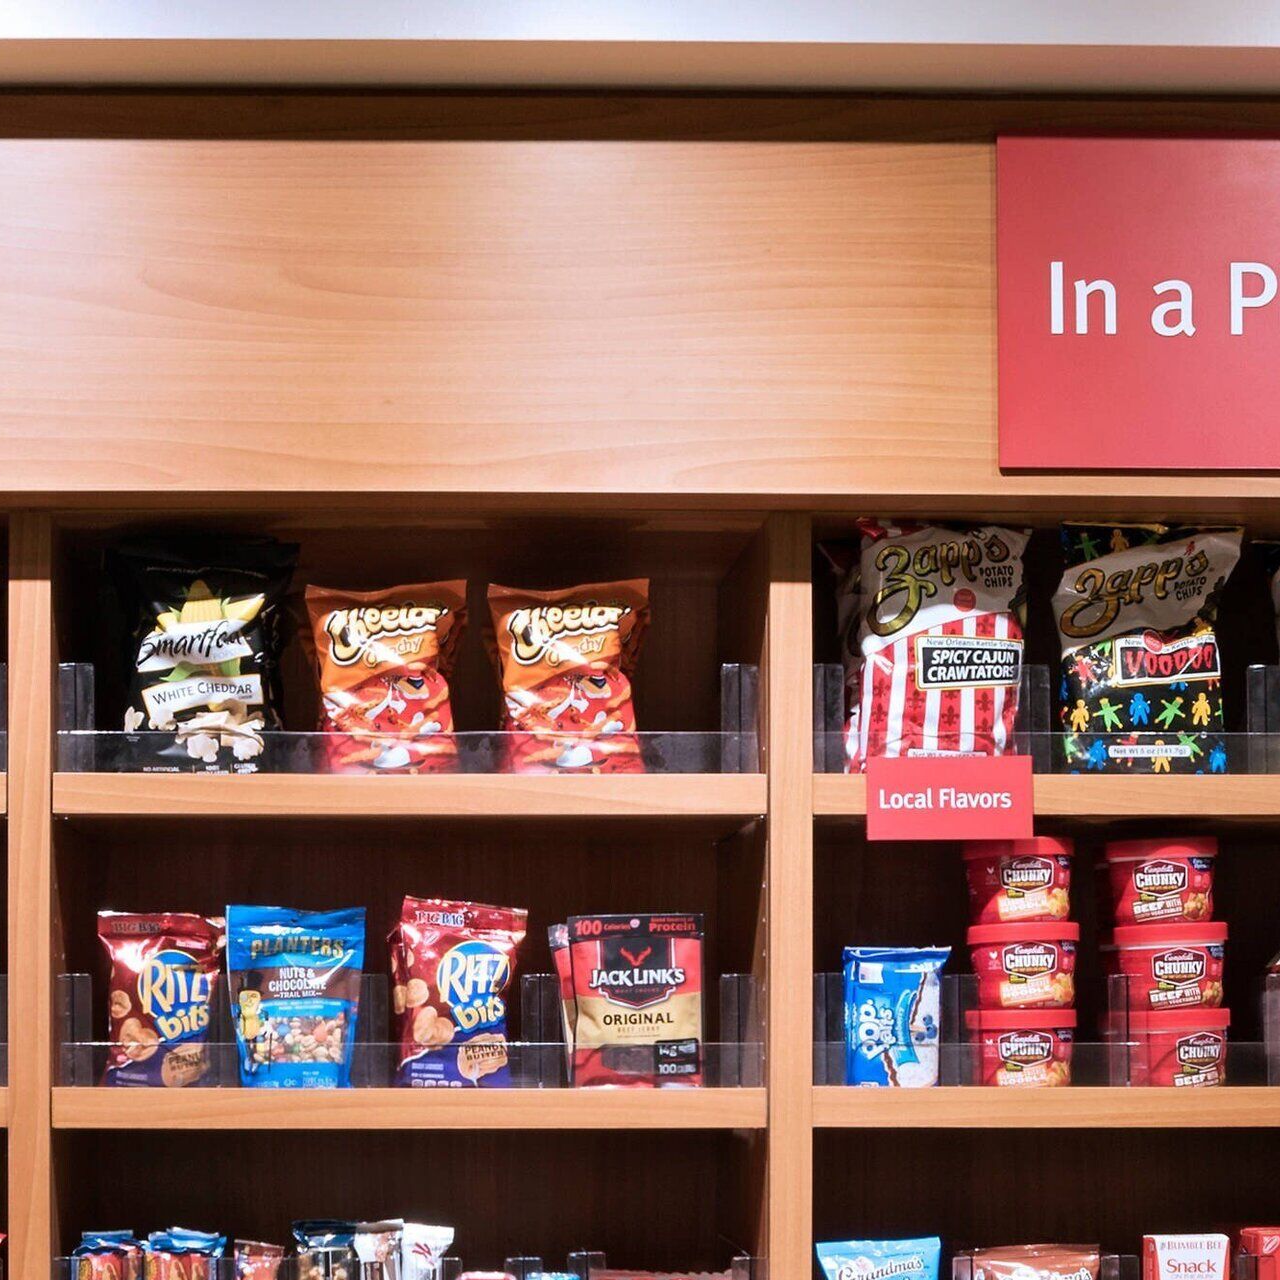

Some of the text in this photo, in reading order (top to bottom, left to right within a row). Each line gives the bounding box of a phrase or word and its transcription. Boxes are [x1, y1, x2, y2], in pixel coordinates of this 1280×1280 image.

[1049, 260, 1118, 335] In
[1150, 279, 1197, 338] a
[979, 565, 1015, 578] POTATO
[984, 577, 1014, 588] CHIPS
[1173, 576, 1207, 592] POTATO
[1175, 586, 1203, 601] CHIPS
[931, 650, 1015, 665] SPICY CAJUN
[1125, 642, 1215, 677] VOODOO
[927, 665, 1014, 682] CRAWTATORS
[152, 682, 253, 705] WHITE CHEDDAR
[879, 788, 1012, 810] Local Flavors
[1003, 868, 1053, 884] CHUNKY
[1135, 872, 1185, 888] CHUNKY
[440, 912, 465, 926] BAG
[649, 921, 697, 933] Protein
[574, 919, 603, 936] 100
[251, 936, 344, 960] PLANTERS
[1005, 954, 1055, 969] CHUNKY
[1154, 961, 1204, 976] CHUNKY
[279, 967, 316, 979] NUTS &
[440, 951, 509, 1003] RITZ
[589, 969, 632, 988] JACK
[268, 978, 327, 992] CHOCOLATE
[454, 996, 505, 1030] bits
[602, 1012, 675, 1027] ORIGINAL
[158, 1004, 210, 1040] bits
[1001, 1042, 1051, 1057] CHUNKY
[1166, 1259, 1217, 1274] Snack
